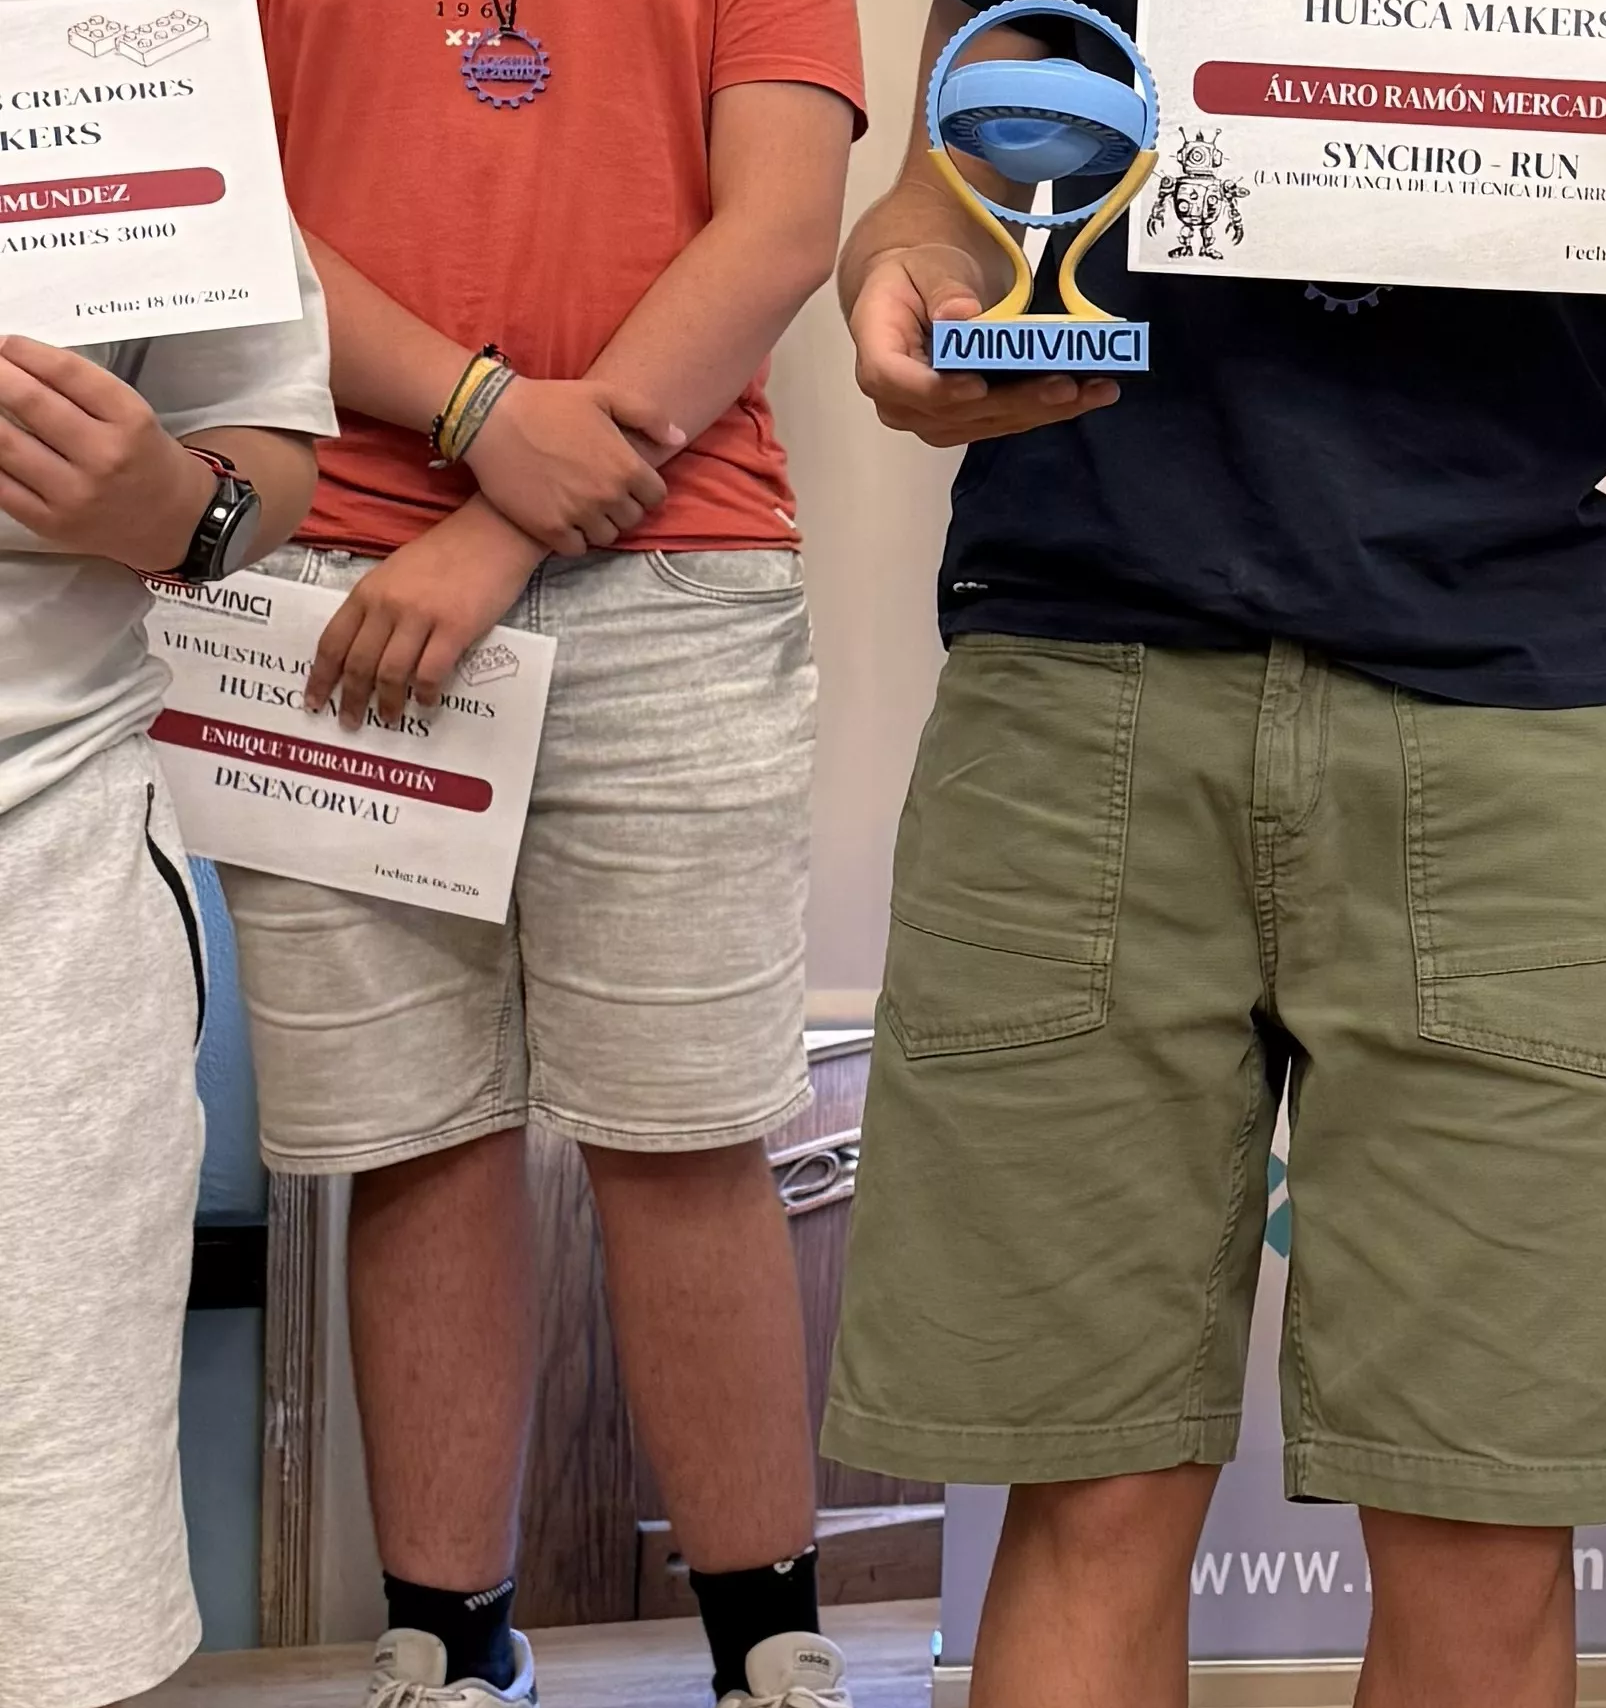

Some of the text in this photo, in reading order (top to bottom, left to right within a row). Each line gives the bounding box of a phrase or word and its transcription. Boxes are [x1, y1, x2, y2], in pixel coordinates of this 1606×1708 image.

[11, 78, 194, 111] CREADORES
[1264, 73, 1378, 108] ÁLVARO
[1384, 83, 1486, 114] RAMÓN
[0, 122, 102, 151] KERS
[1322, 141, 1482, 176] SYNCHRO
[1510, 151, 1580, 180] RUN
[0, 183, 130, 213] MUNDEZ
[1286, 171, 1403, 194] IMPORTANCIA
[1, 223, 176, 253] ADORES 3000
[939, 328, 1141, 362] MINIVINCI
[164, 631, 188, 650] VII
[192, 637, 285, 673] MUESTRA
[219, 674, 319, 713] HUESC
[202, 725, 436, 792] ENRIQUE TORRALBA OTÍN
[215, 767, 400, 825] DESENCORVAU
